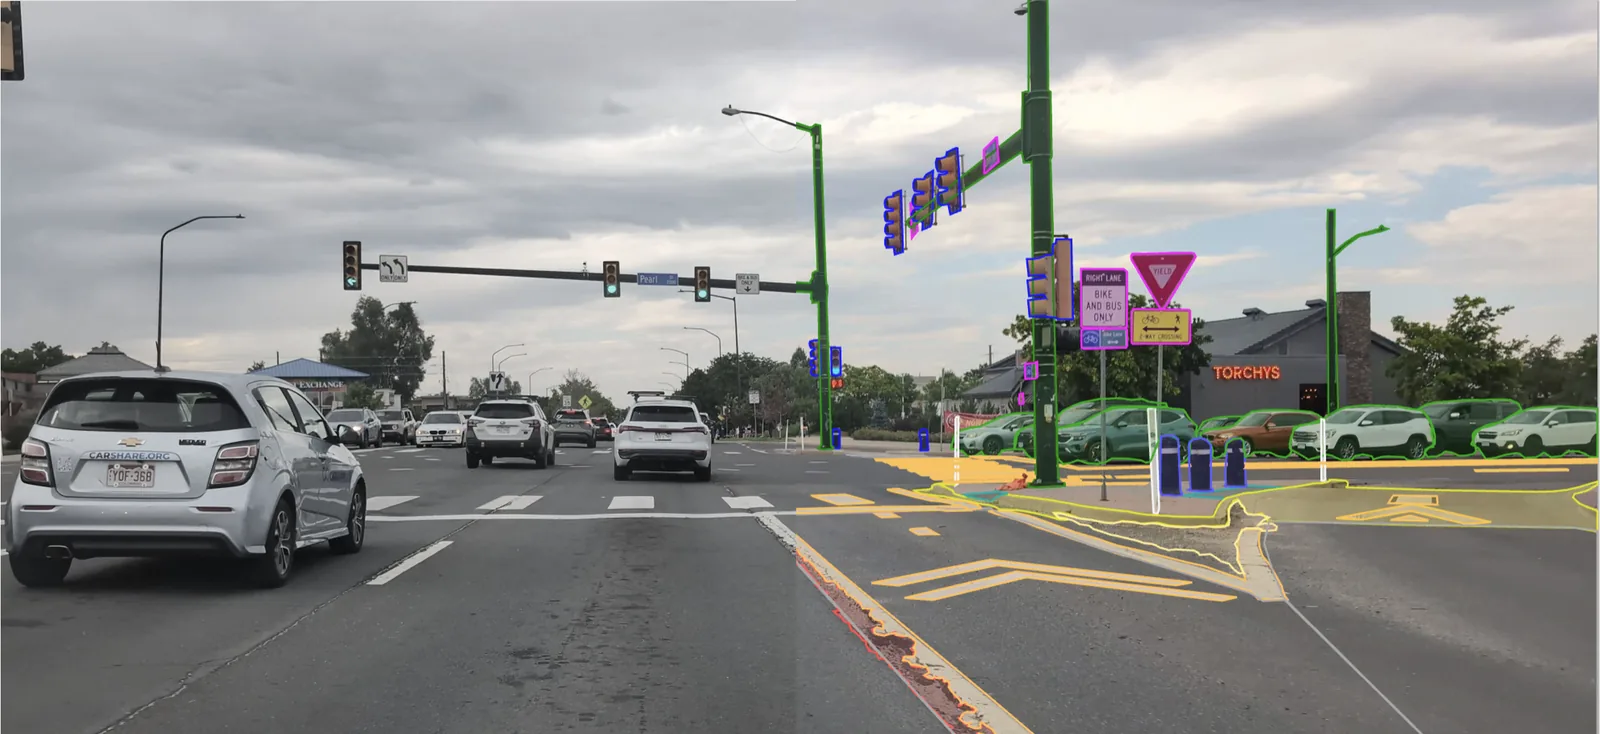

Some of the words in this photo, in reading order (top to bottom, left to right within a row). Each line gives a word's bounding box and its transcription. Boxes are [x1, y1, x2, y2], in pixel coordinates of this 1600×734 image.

[640, 274, 658, 284] Pearl
[1086, 274, 1103, 282] RIGHT
[1105, 274, 1122, 282] LANE
[1094, 290, 1113, 299] BIKE
[1086, 302, 1102, 311] AND
[1105, 301, 1122, 311] BUS
[1093, 313, 1114, 322] ONLY
[1213, 365, 1281, 380] TORCHYS
[300, 381, 344, 389] EXCHANGE
[89, 452, 170, 460] CARSHARE.ORG
